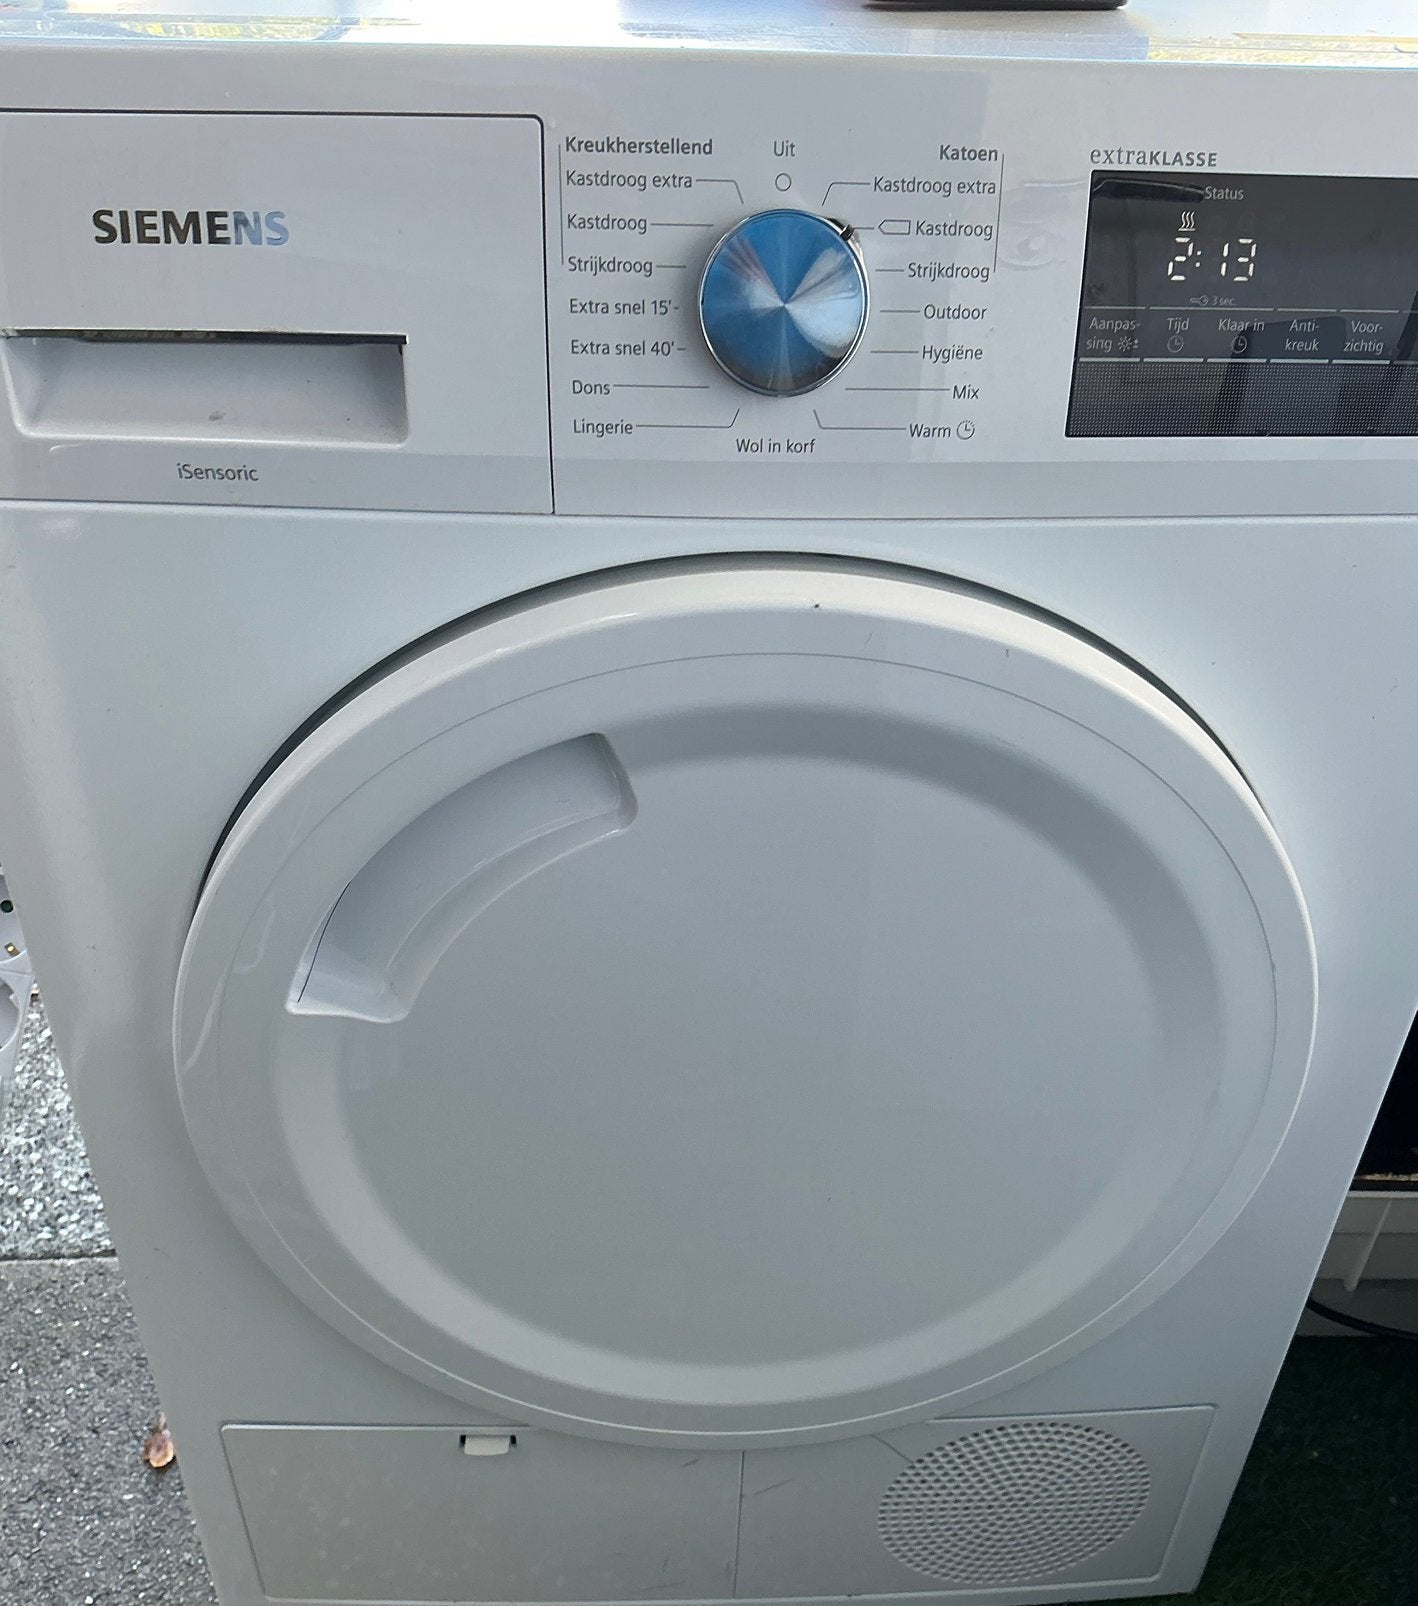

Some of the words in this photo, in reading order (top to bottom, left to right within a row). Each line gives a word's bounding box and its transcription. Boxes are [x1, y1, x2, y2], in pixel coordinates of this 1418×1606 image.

[565, 136, 713, 155] Kreukherstellend
[773, 140, 796, 157] Uit
[939, 144, 998, 162] Katoen
[1090, 147, 1218, 167] extraKLASSE
[566, 170, 647, 191] Kastdroog
[652, 173, 692, 189] extra
[873, 176, 952, 197] Kastdroog
[957, 178, 996, 195] extra
[1204, 186, 1244, 200] Status
[92, 209, 290, 245] SIEMENS
[567, 213, 648, 234] Kastdroog
[915, 220, 993, 241] Kastdroog
[568, 256, 653, 277] Strijkdroog
[908, 262, 990, 283] Strijkdroog
[569, 299, 609, 315] Extra
[614, 299, 646, 315] snel
[923, 303, 987, 320] Outdoor
[1089, 318, 1141, 332] Aanpas-
[1167, 318, 1190, 333] Tijd
[1218, 318, 1248, 331] Klaar
[1252, 318, 1265, 331] in
[1289, 319, 1320, 332] Anti-
[1351, 320, 1384, 333] Voor-
[571, 340, 610, 355] Extra
[615, 340, 646, 356] snel
[1086, 336, 1113, 352] sing
[1285, 338, 1319, 351] kreuk
[1344, 339, 1384, 355] zichtig
[922, 344, 983, 363] Hygiëne
[572, 380, 611, 395] Dons
[953, 384, 980, 400] Mix
[573, 419, 633, 437] Lingerie
[909, 424, 951, 438] Warm
[736, 438, 763, 453] Wol
[767, 438, 781, 453] in
[786, 438, 816, 453] korf
[176, 462, 260, 482] iSensoric
